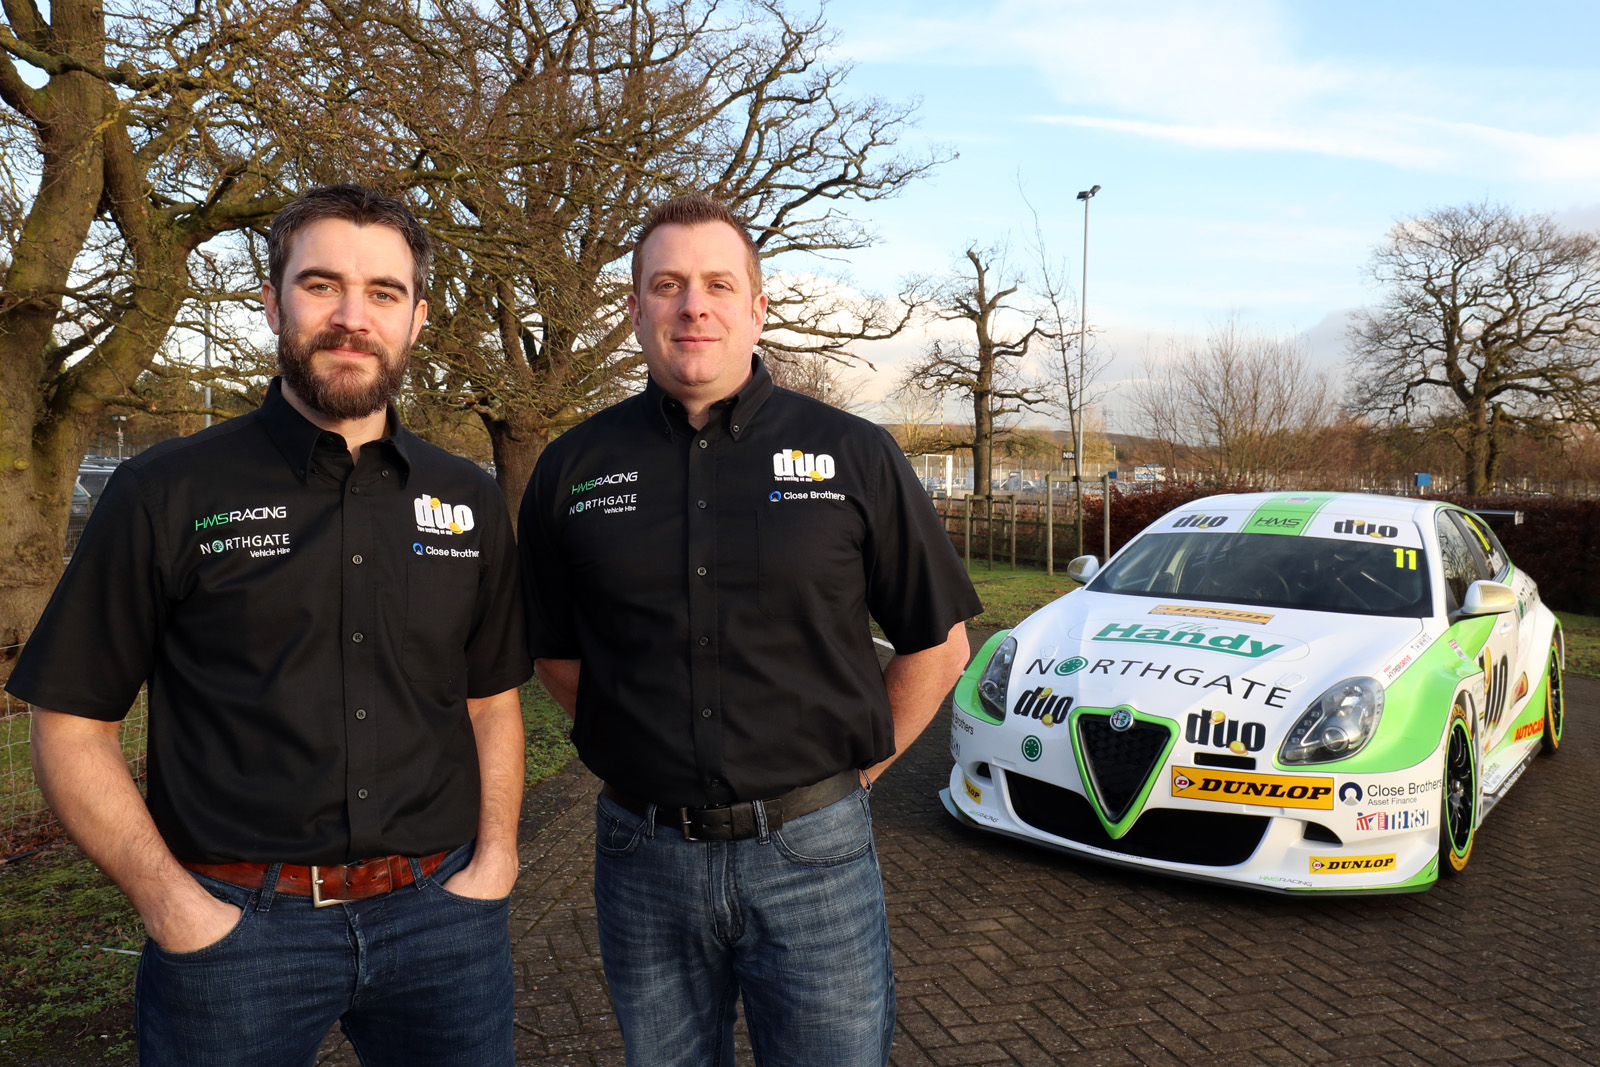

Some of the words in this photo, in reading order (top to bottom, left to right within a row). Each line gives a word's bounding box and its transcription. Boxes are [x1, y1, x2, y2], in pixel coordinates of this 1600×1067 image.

[773, 449, 835, 480] duo
[569, 493, 637, 515] NORTHGATE
[783, 491, 808, 500] Close
[810, 491, 846, 501] Brothers
[414, 493, 475, 532] duo
[603, 506, 624, 514] Vehicle
[1171, 514, 1229, 529] duo
[1254, 517, 1303, 526] HMS
[1333, 519, 1398, 538] duo
[199, 533, 290, 555] NORTHGATE
[250, 548, 276, 558] Vehicle
[276, 547, 291, 555] Hire
[425, 545, 450, 556] Close
[450, 548, 480, 558] Brother
[1393, 548, 1417, 571] 11
[1173, 607, 1272, 619] DUNLOP
[1094, 622, 1286, 658] Handy
[1026, 656, 1291, 708] NORTHGATE
[1013, 686, 1074, 726] duo
[1185, 708, 1266, 754] duo
[1198, 778, 1332, 800] DUNLOP
[1367, 784, 1405, 797] Close
[1408, 779, 1442, 795] Brothers
[1367, 798, 1389, 806] Asset
[1391, 797, 1418, 805] Finance
[1327, 858, 1394, 870] DUNLOP
